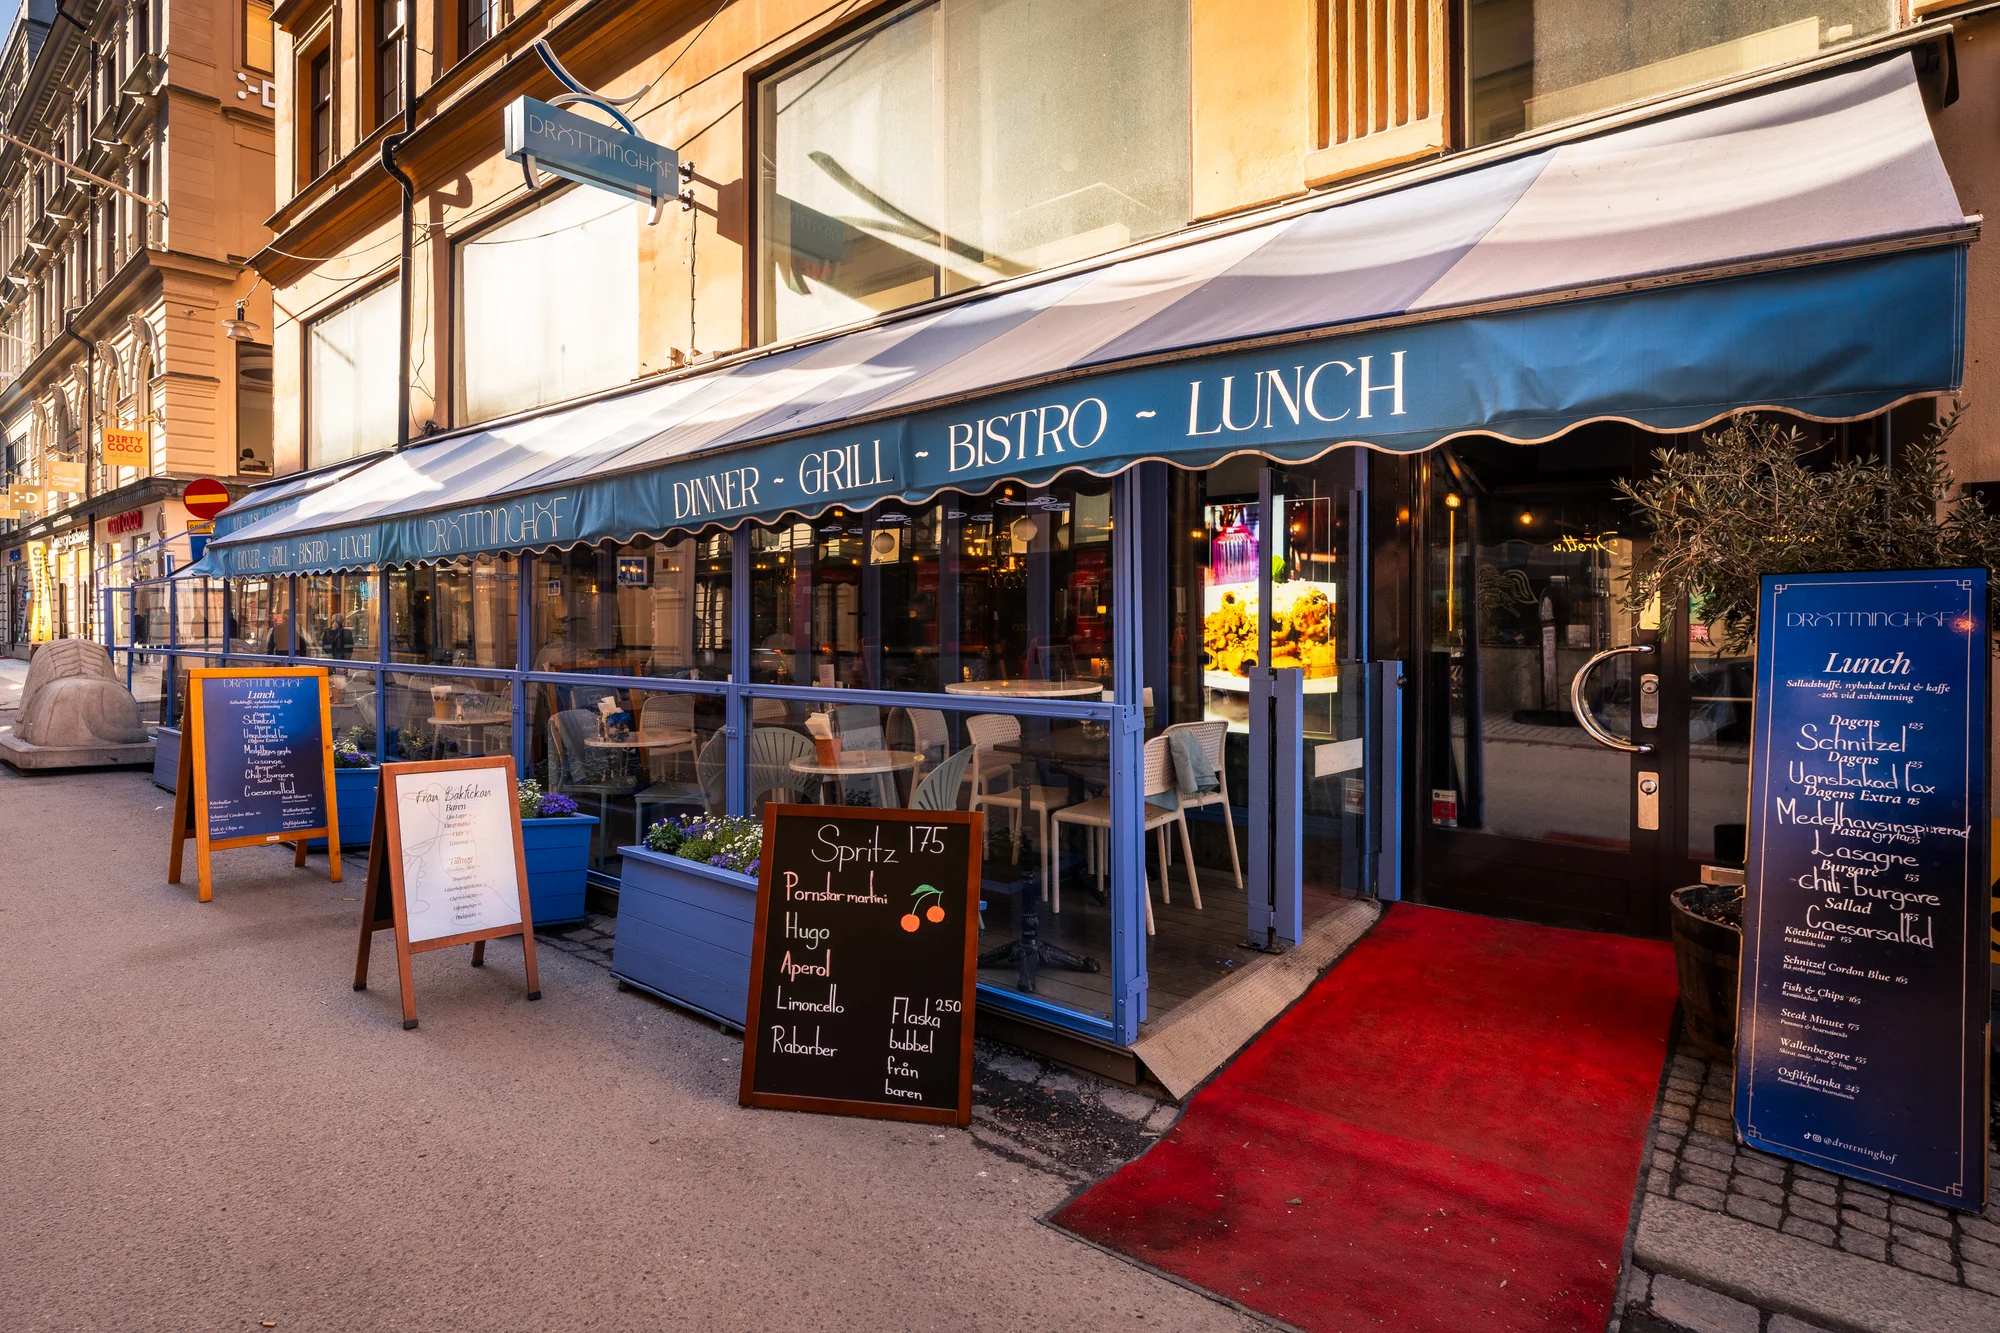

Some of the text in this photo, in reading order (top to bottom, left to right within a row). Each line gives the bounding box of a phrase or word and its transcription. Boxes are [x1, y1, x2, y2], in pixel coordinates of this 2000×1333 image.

[108, 434, 143, 445] DIRTY
[674, 466, 760, 520] DINNER
[799, 439, 896, 495] GRILL
[948, 397, 1108, 473] BISTRO
[1186, 350, 1408, 437] LUNCH
[108, 444, 143, 453] COCO
[52, 475, 81, 483] Change
[238, 534, 371, 570] DINNER GRILL BISTRO LUNCH
[1823, 652, 1911, 675] Lunch
[248, 690, 275, 699] Lunch
[1786, 680, 1842, 691] Salladsbuffé,
[1845, 682, 1886, 692] nybakad
[1887, 683, 1910, 691] bröd
[1926, 684, 1951, 694] kaffe
[1857, 693, 1914, 703] avhämtning
[278, 728, 288, 739] lax
[1829, 714, 1924, 731] Dagens 125
[1796, 723, 1906, 753] Schnitzel
[1828, 751, 1923, 769] Dagens 125
[1789, 760, 1936, 794] Ugnsbakad lax
[244, 782, 295, 797] Caesarsallad
[445, 784, 491, 801] Bakfickan
[1804, 784, 1855, 801] Dagens
[1860, 790, 1901, 805] Extra
[446, 804, 466, 812] Baren
[1830, 825, 1871, 839] Pasta
[1872, 831, 1907, 845] gryta
[811, 824, 948, 872] Spritz 175
[1811, 830, 1920, 871] Lasagne
[1820, 859, 1920, 883] Burgare 155
[784, 870, 888, 905] Pornstar martini
[1824, 897, 1872, 915] Sallad
[785, 911, 831, 950] Hugo
[1784, 926, 1852, 944] Köttbullar 155
[1806, 904, 1934, 948] Caesarsallad
[780, 949, 831, 983] Aperol
[1784, 955, 1909, 985] Schnitzel Cordon Blue 165
[777, 984, 845, 1014] Limoncello
[1782, 982, 1862, 1005] Fish & Chips 165
[892, 996, 962, 1029] Flaska 250
[1781, 1008, 1860, 1031] Steak Minute 175
[771, 1024, 838, 1057] Rabarber
[890, 1028, 934, 1054] bubbel
[1780, 1037, 1867, 1065] Wallenbergare 155
[887, 1056, 919, 1079] från
[885, 1078, 923, 1101] baren
[1778, 1066, 1860, 1094] Oxfiléplanka 245
[1824, 1137, 1898, 1164] @drottninghof
